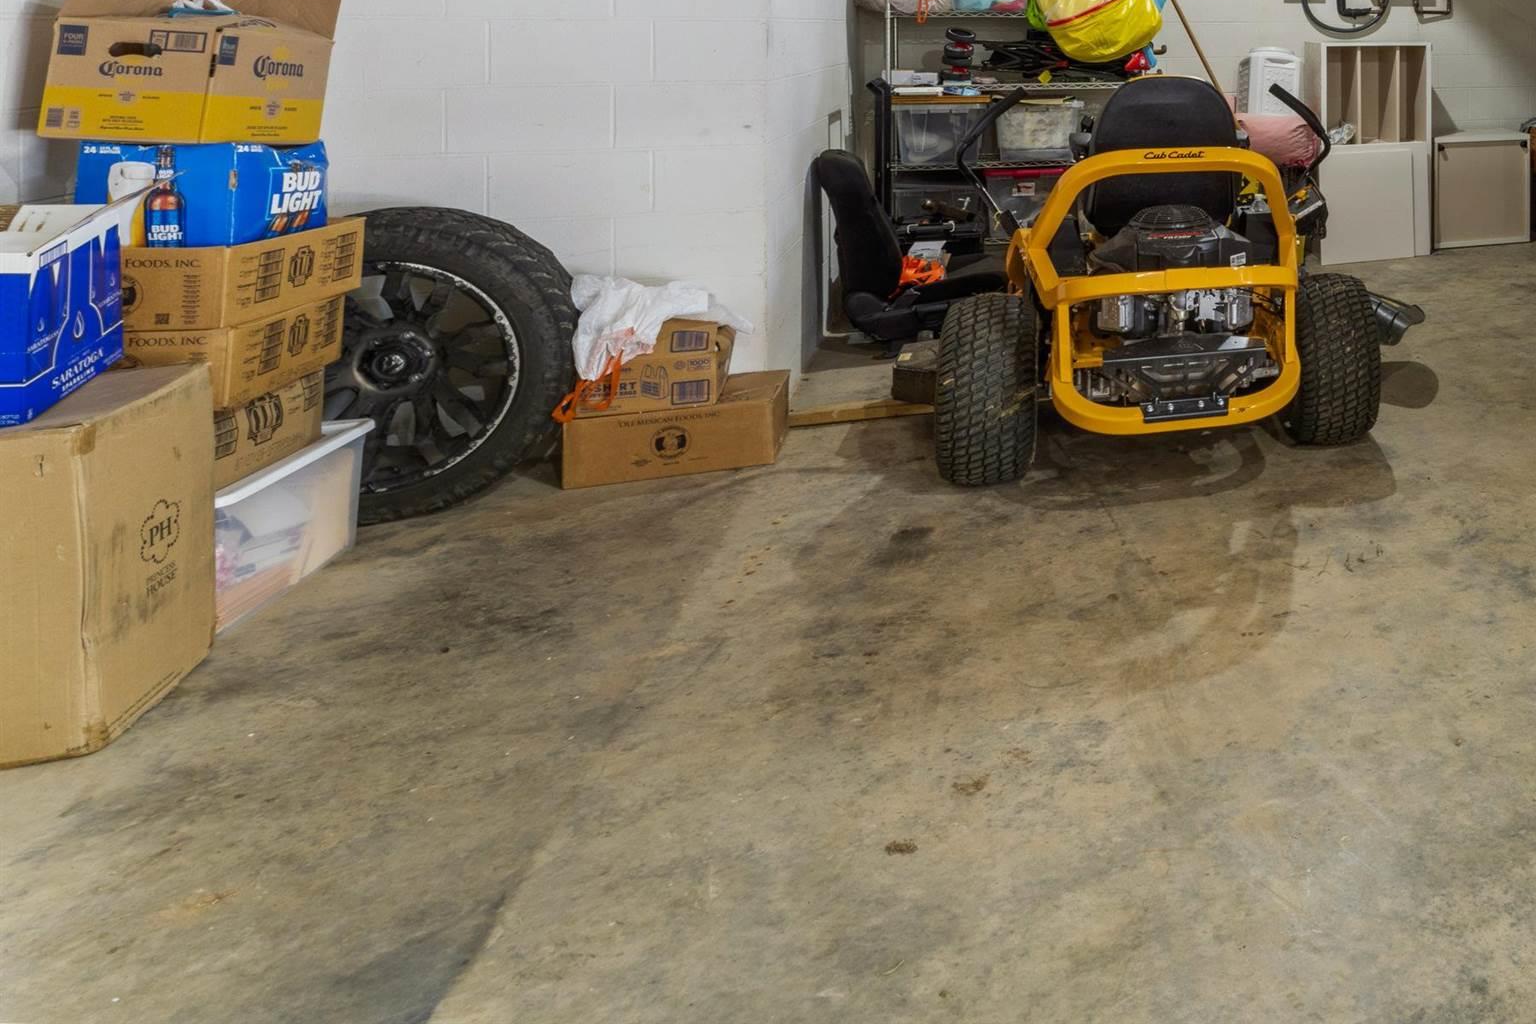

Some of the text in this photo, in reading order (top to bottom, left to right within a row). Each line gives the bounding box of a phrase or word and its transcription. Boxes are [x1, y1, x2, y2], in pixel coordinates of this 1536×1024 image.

[98, 60, 163, 78] Corona
[253, 55, 304, 80] Corona
[83, 145, 97, 154] 24
[236, 145, 249, 153] 24
[1143, 150, 1205, 160] Cub Cadet
[282, 171, 321, 192] BUD
[270, 189, 323, 214] LIGHT
[148, 231, 184, 241] LIGHT
[151, 224, 180, 234] BUD
[51, 347, 104, 389] SARATOGA
[637, 416, 674, 426] MEXICAN
[149, 516, 172, 548] PH
[146, 567, 178, 597] HOUSE
